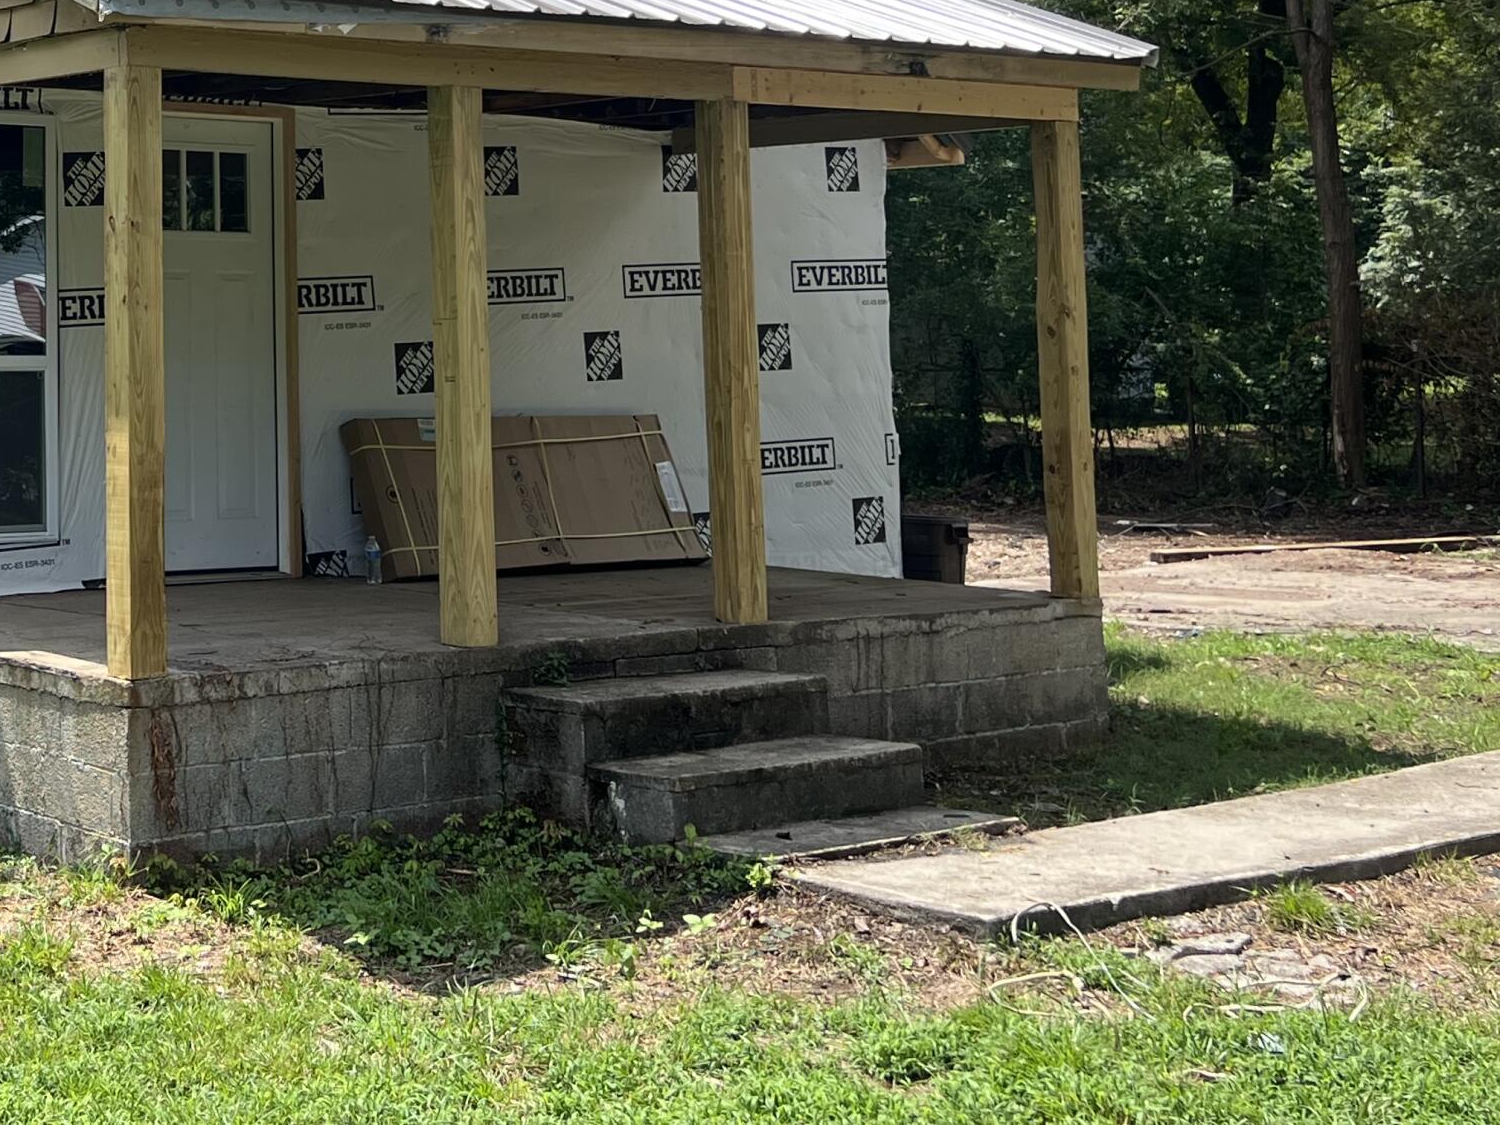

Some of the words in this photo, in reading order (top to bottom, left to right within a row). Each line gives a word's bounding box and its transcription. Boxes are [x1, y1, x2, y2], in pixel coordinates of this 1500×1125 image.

[67, 158, 86, 180] THE
[399, 347, 416, 366] THE
[585, 331, 621, 381] HOME
